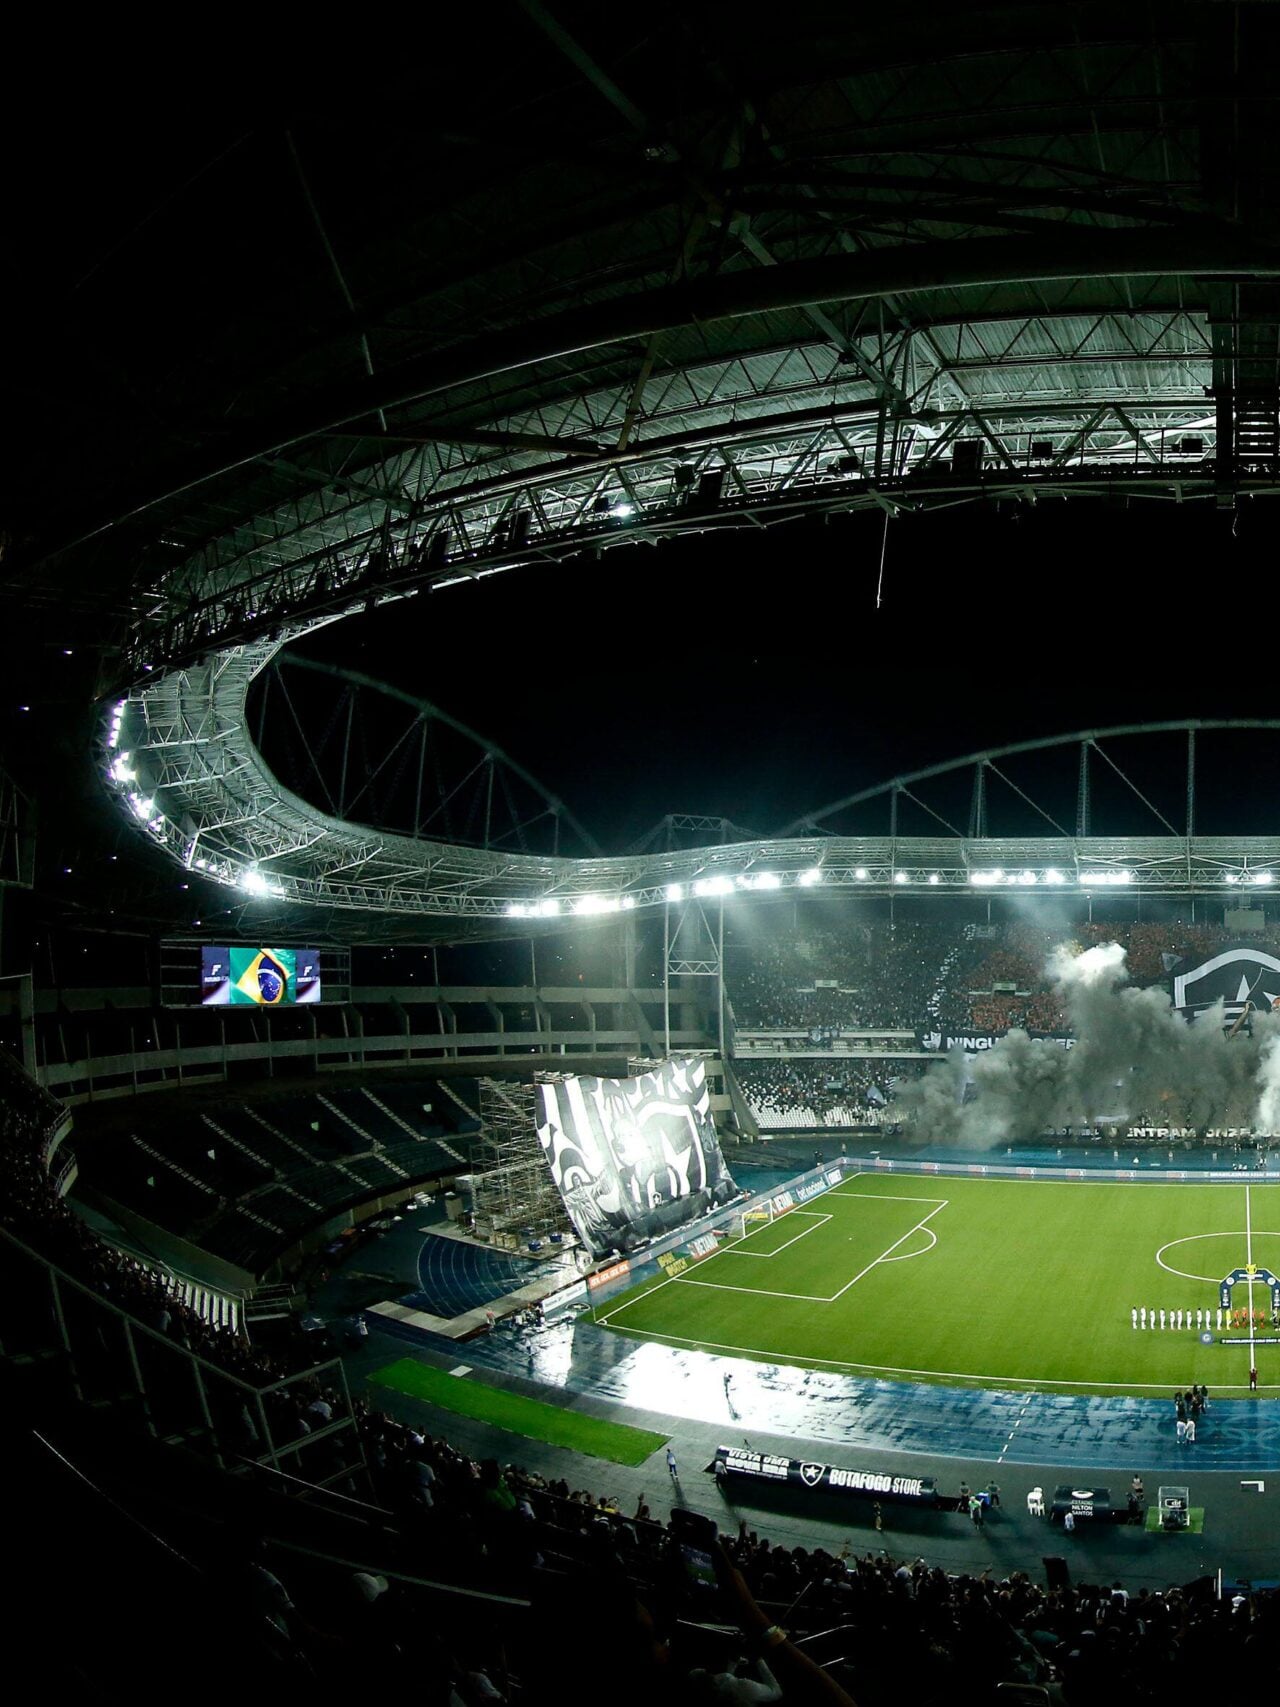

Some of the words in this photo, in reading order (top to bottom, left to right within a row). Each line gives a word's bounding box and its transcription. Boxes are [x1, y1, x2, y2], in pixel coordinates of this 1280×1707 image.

[728, 1448, 761, 1462] VISTA
[829, 1468, 892, 1492] BOTAFOGO
[892, 1477, 923, 1496] STORE
